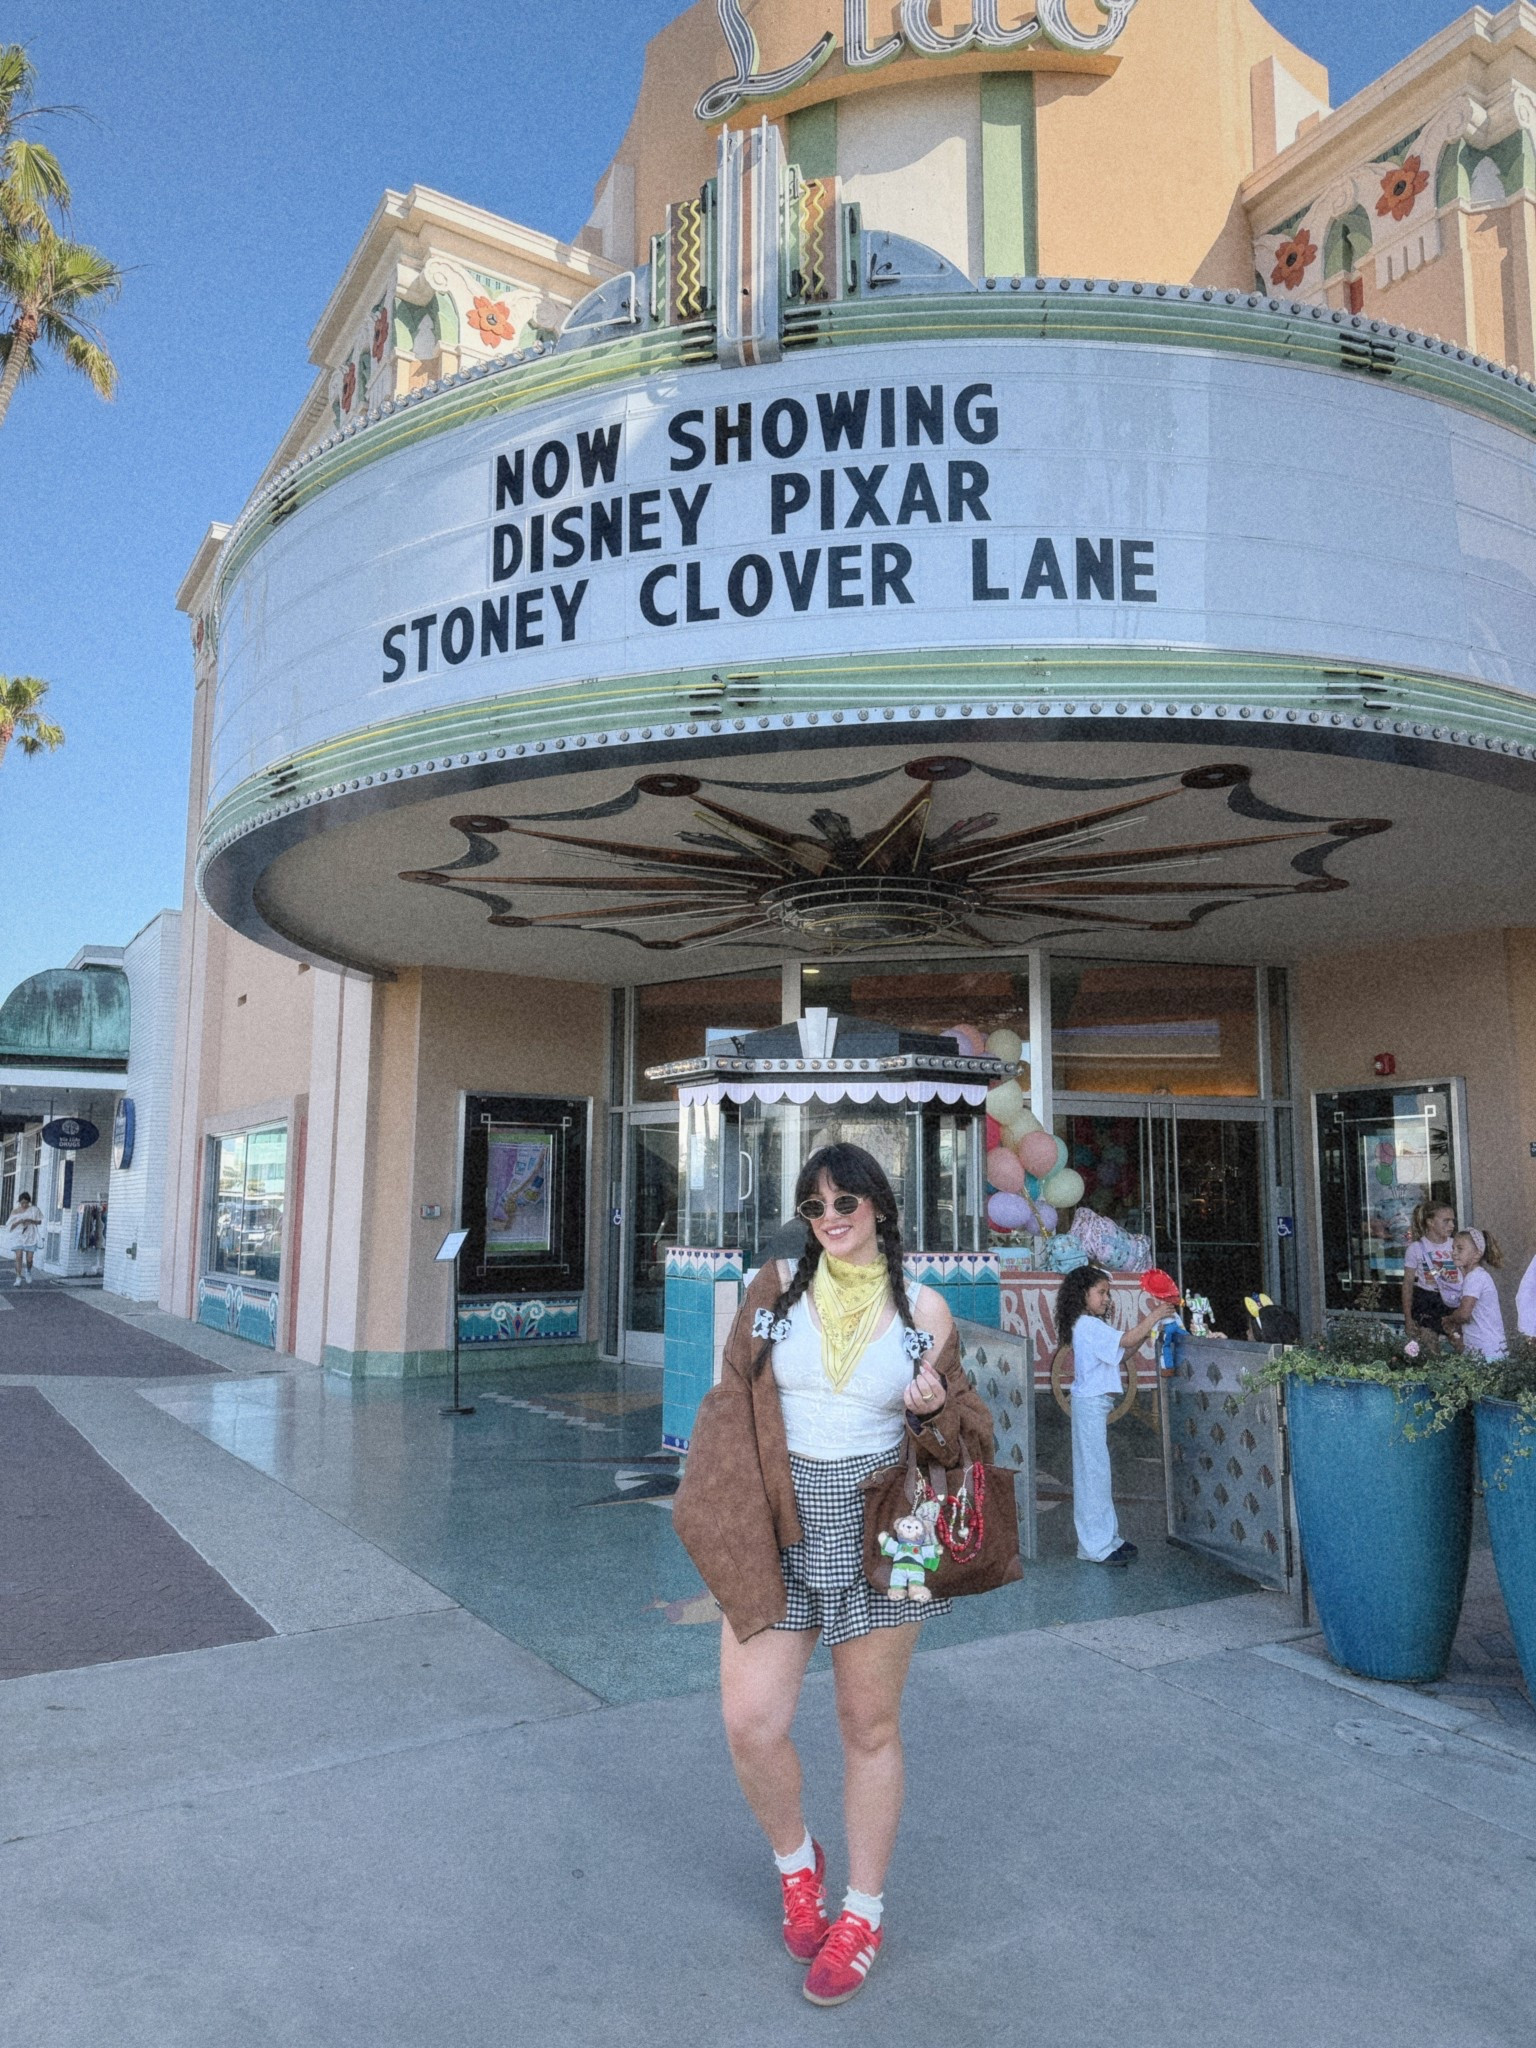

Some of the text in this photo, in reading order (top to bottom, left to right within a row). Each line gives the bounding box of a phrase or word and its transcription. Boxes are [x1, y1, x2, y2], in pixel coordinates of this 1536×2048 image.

[495, 383, 999, 511] NOW SHOWING
[492, 460, 991, 583] DISNEY PIXAR
[382, 537, 1157, 683] STONEY CLOVER LANE
[1000, 1288, 1161, 1360] BAONS
